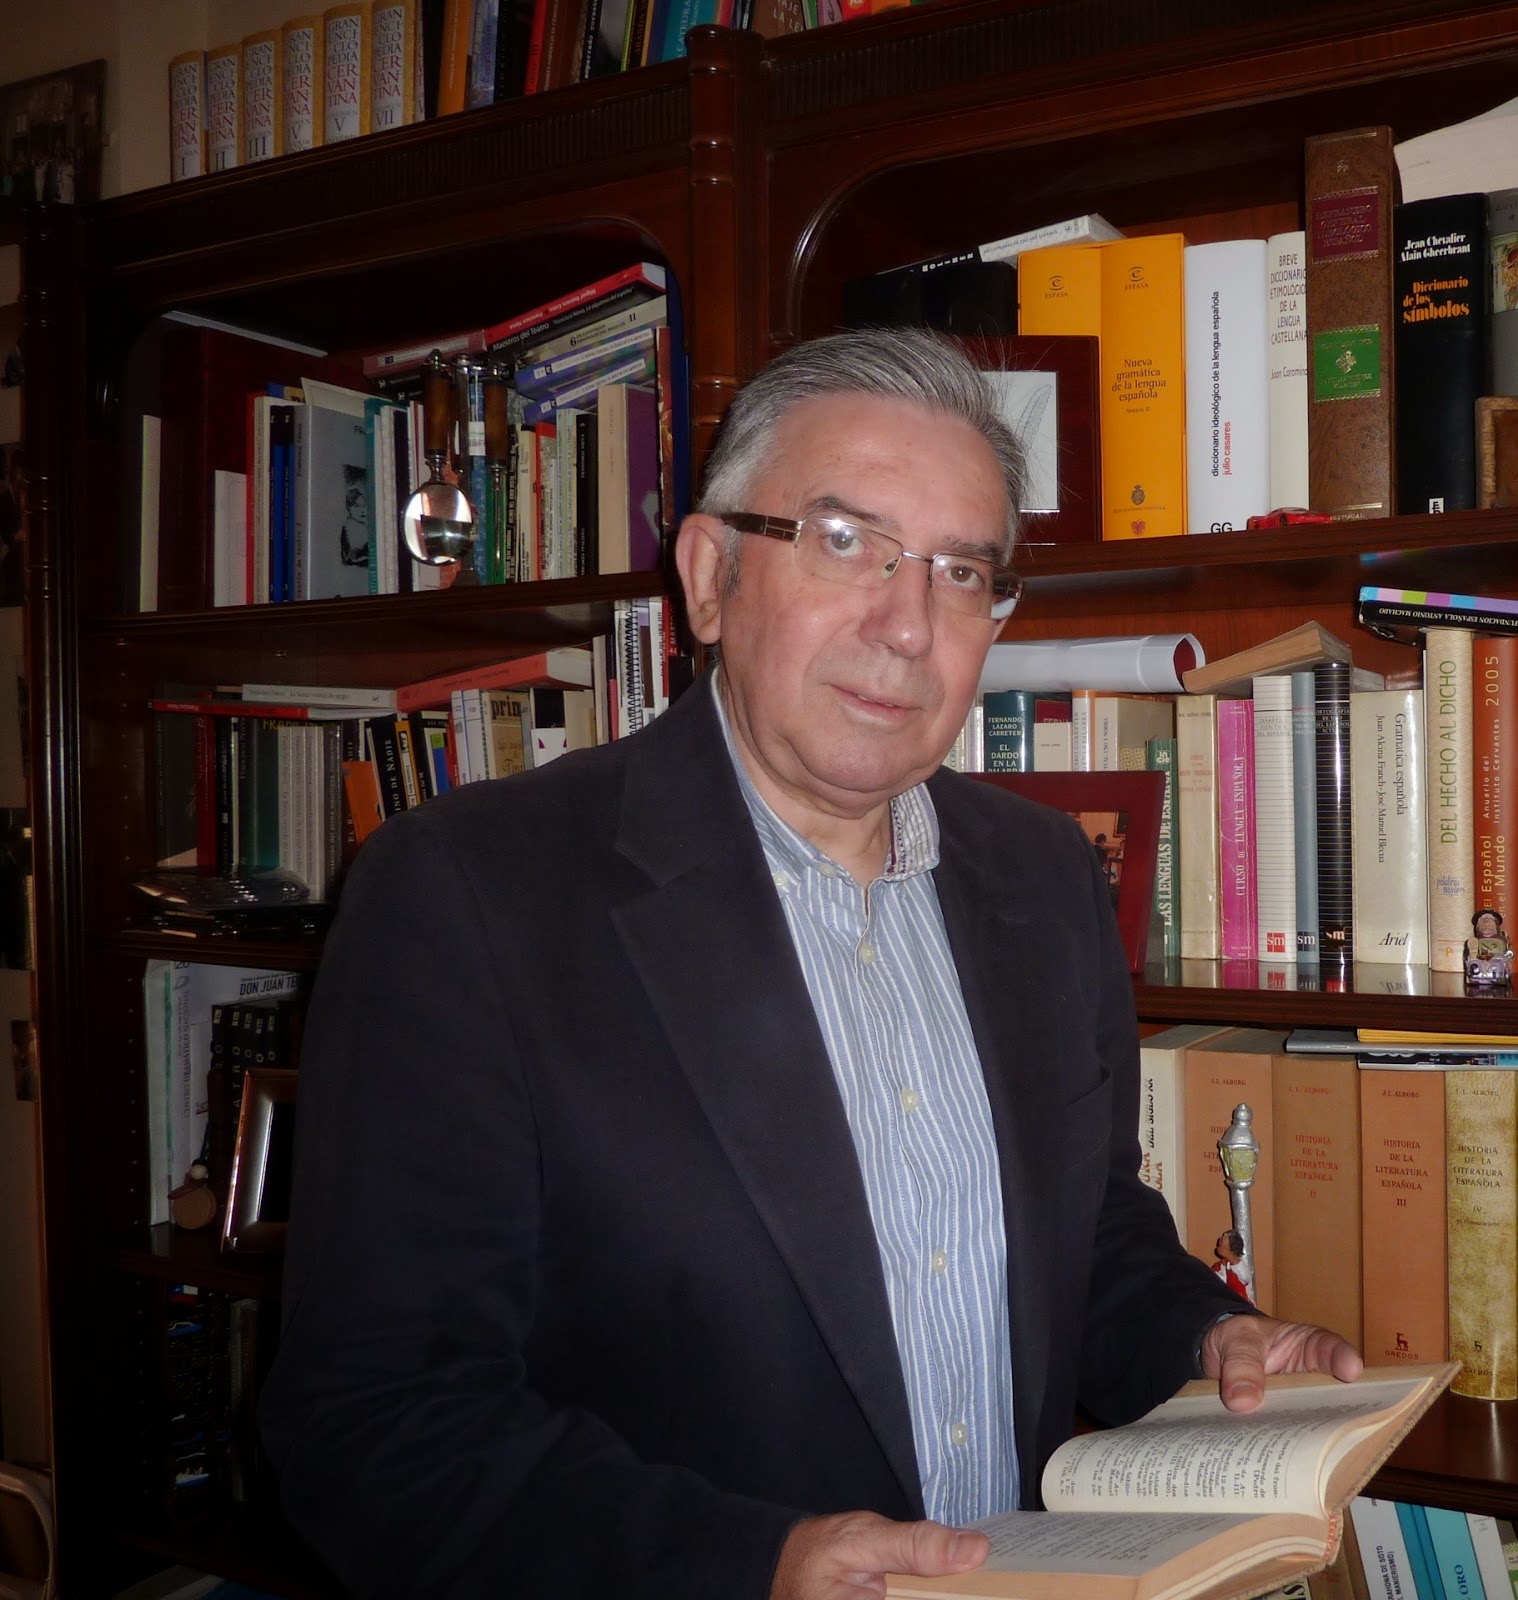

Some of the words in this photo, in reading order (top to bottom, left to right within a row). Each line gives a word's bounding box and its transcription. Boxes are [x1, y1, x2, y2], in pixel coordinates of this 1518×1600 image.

[334, 41, 358, 52] CLO
[328, 63, 359, 81] CER
[334, 117, 345, 132] V
[376, 109, 394, 126] VII
[249, 135, 266, 159] III
[215, 151, 226, 172] II
[1404, 239, 1426, 251] Jean
[1426, 232, 1467, 247] Chevalier
[1423, 243, 1472, 258] Gheerbrant
[922, 252, 974, 273] MOLINER
[1279, 254, 1298, 267] BREVE
[1124, 282, 1150, 291] ESPASA
[1412, 276, 1469, 295] Diccionario
[1045, 291, 1069, 299] ESPASA
[1403, 294, 1415, 308] de
[1416, 293, 1431, 306] los
[1211, 291, 1221, 330] española
[1279, 301, 1288, 313] DE
[1290, 299, 1298, 311] LA
[1403, 300, 1471, 323] símbolos
[628, 312, 637, 321] II
[1282, 315, 1301, 329] LENGUA
[492, 336, 520, 352] Maestros
[519, 330, 531, 341] del
[529, 322, 550, 337] Teatro
[568, 336, 577, 346] 6
[1271, 330, 1308, 345] CASTELLANA
[1211, 332, 1221, 360] lengua
[1124, 359, 1152, 369] Nueva
[1211, 361, 1220, 369] la
[1116, 368, 1161, 383] gramática
[1211, 371, 1220, 382] de
[1271, 369, 1282, 381] Joan
[1111, 382, 1122, 392] de
[1124, 380, 1132, 390] la
[1135, 379, 1167, 390] lengua
[1119, 388, 1158, 403] española
[1211, 383, 1221, 428] ideológico
[1211, 430, 1219, 477] diccionario
[1222, 458, 1232, 476] julio
[1210, 522, 1233, 534] GG
[296, 558, 300, 567] de
[1378, 607, 1410, 616] MACHADO
[1412, 610, 1441, 619] ANTONIO
[1444, 612, 1477, 622] ESPAÑOLA
[1439, 660, 1456, 714] DICHO
[1485, 656, 1499, 706] 2005
[987, 716, 1022, 724] FERNANDO
[991, 722, 1017, 731] LÁZARO
[1376, 714, 1384, 731] Juan
[987, 730, 1021, 738] CARRETER
[1439, 720, 1456, 741] AL
[1395, 714, 1406, 767] Gramática
[1492, 717, 1500, 770] Cervantes
[998, 744, 1009, 752] EL
[383, 739, 396, 772] NADIE
[991, 751, 1020, 760] DARDO
[993, 760, 1004, 768] EN
[390, 774, 398, 790] DE
[1233, 757, 1245, 802] ESPAÑOLA
[1440, 748, 1456, 807] HECHO
[1393, 771, 1406, 815] española
[1492, 775, 1500, 823] Instituto
[1235, 809, 1244, 841] LENGUA
[1377, 808, 1385, 836] Manuel
[1440, 813, 1457, 842] DEL
[1160, 822, 1171, 838] DE
[1378, 838, 1386, 863] Blecua
[1480, 835, 1493, 892] Español
[1494, 835, 1505, 886] Mundo
[1158, 843, 1171, 898] LENGUAS
[1235, 864, 1245, 895] CURSO
[1483, 898, 1492, 908] El
[1496, 892, 1506, 902] el
[1159, 901, 1171, 925] LAS
[1267, 935, 1285, 946] sm
[1296, 933, 1316, 945] sm
[1324, 928, 1345, 940] sm
[1378, 931, 1408, 946] Ariel
[239, 979, 258, 996] DON
[260, 976, 284, 992] JUAN
[183, 990, 191, 1031] NACIONAL
[1222, 1078, 1247, 1086] ALBORG
[1304, 1086, 1330, 1095] ALBORG
[1395, 1089, 1421, 1098] ALBORG
[1471, 1088, 1500, 1098] ALBORG
[1146, 1094, 1154, 1124] SIGLO
[1296, 1134, 1333, 1146] HISTORIA
[1382, 1138, 1422, 1150] HISTORIA
[1301, 1147, 1312, 1157] DE
[1313, 1148, 1327, 1157] LA
[1457, 1144, 1498, 1155] HISTORIA
[1290, 1158, 1339, 1171] LITERATURA
[1389, 1153, 1401, 1162] DE
[1402, 1153, 1415, 1162] LA
[1464, 1156, 1475, 1165] DE
[1479, 1155, 1492, 1165] LA
[1294, 1170, 1334, 1182] ESPAÑOLA
[1375, 1165, 1429, 1178] LITERATURA
[1453, 1165, 1504, 1177] LITERATURA
[1380, 1179, 1423, 1191] ESPAÑOLA
[1456, 1177, 1502, 1188] ESPAÑOLA
[1396, 1198, 1407, 1207] III
[1472, 1205, 1482, 1214] IV
[1385, 1350, 1419, 1360] GREDOS
[1464, 1367, 1494, 1377] GREDOS
[1241, 1468, 1247, 1479] de
[1259, 1450, 1273, 1486] Leonardo
[1274, 1462, 1282, 1474] del
[1259, 1488, 1266, 1498] de
[1376, 1545, 1386, 1564] SOTO
[1381, 1565, 1388, 1573] DE
[1387, 1551, 1403, 1595] MANIERISMO)
[1454, 1564, 1469, 1596] ORO
